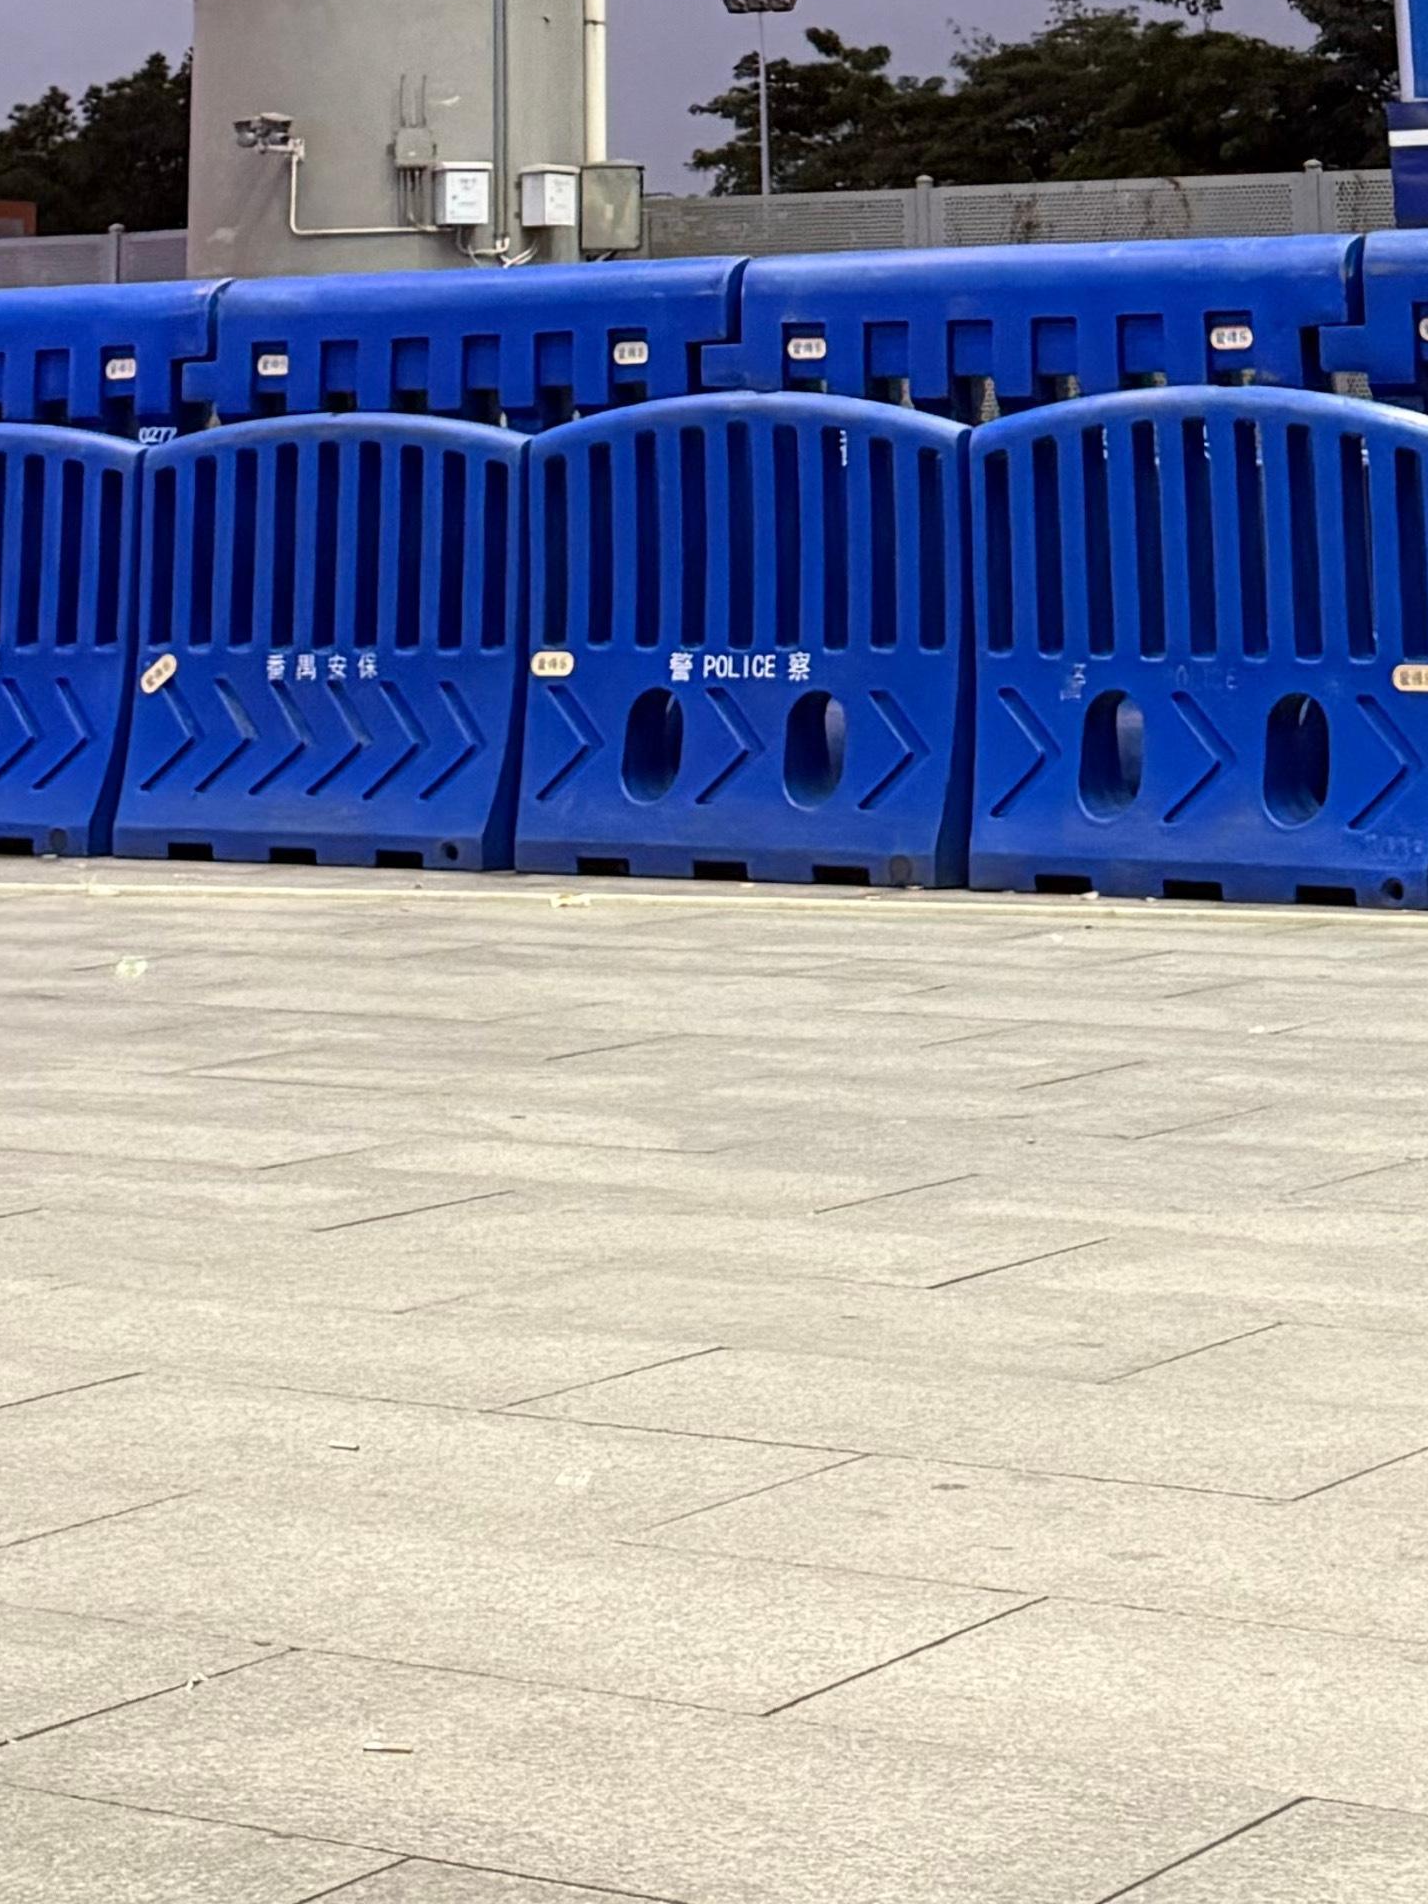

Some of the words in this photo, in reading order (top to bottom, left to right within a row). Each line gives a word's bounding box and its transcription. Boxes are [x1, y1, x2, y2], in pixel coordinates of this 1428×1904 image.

[668, 651, 694, 682] 警
[703, 654, 777, 679] POLICE
[787, 651, 812, 682] 察
